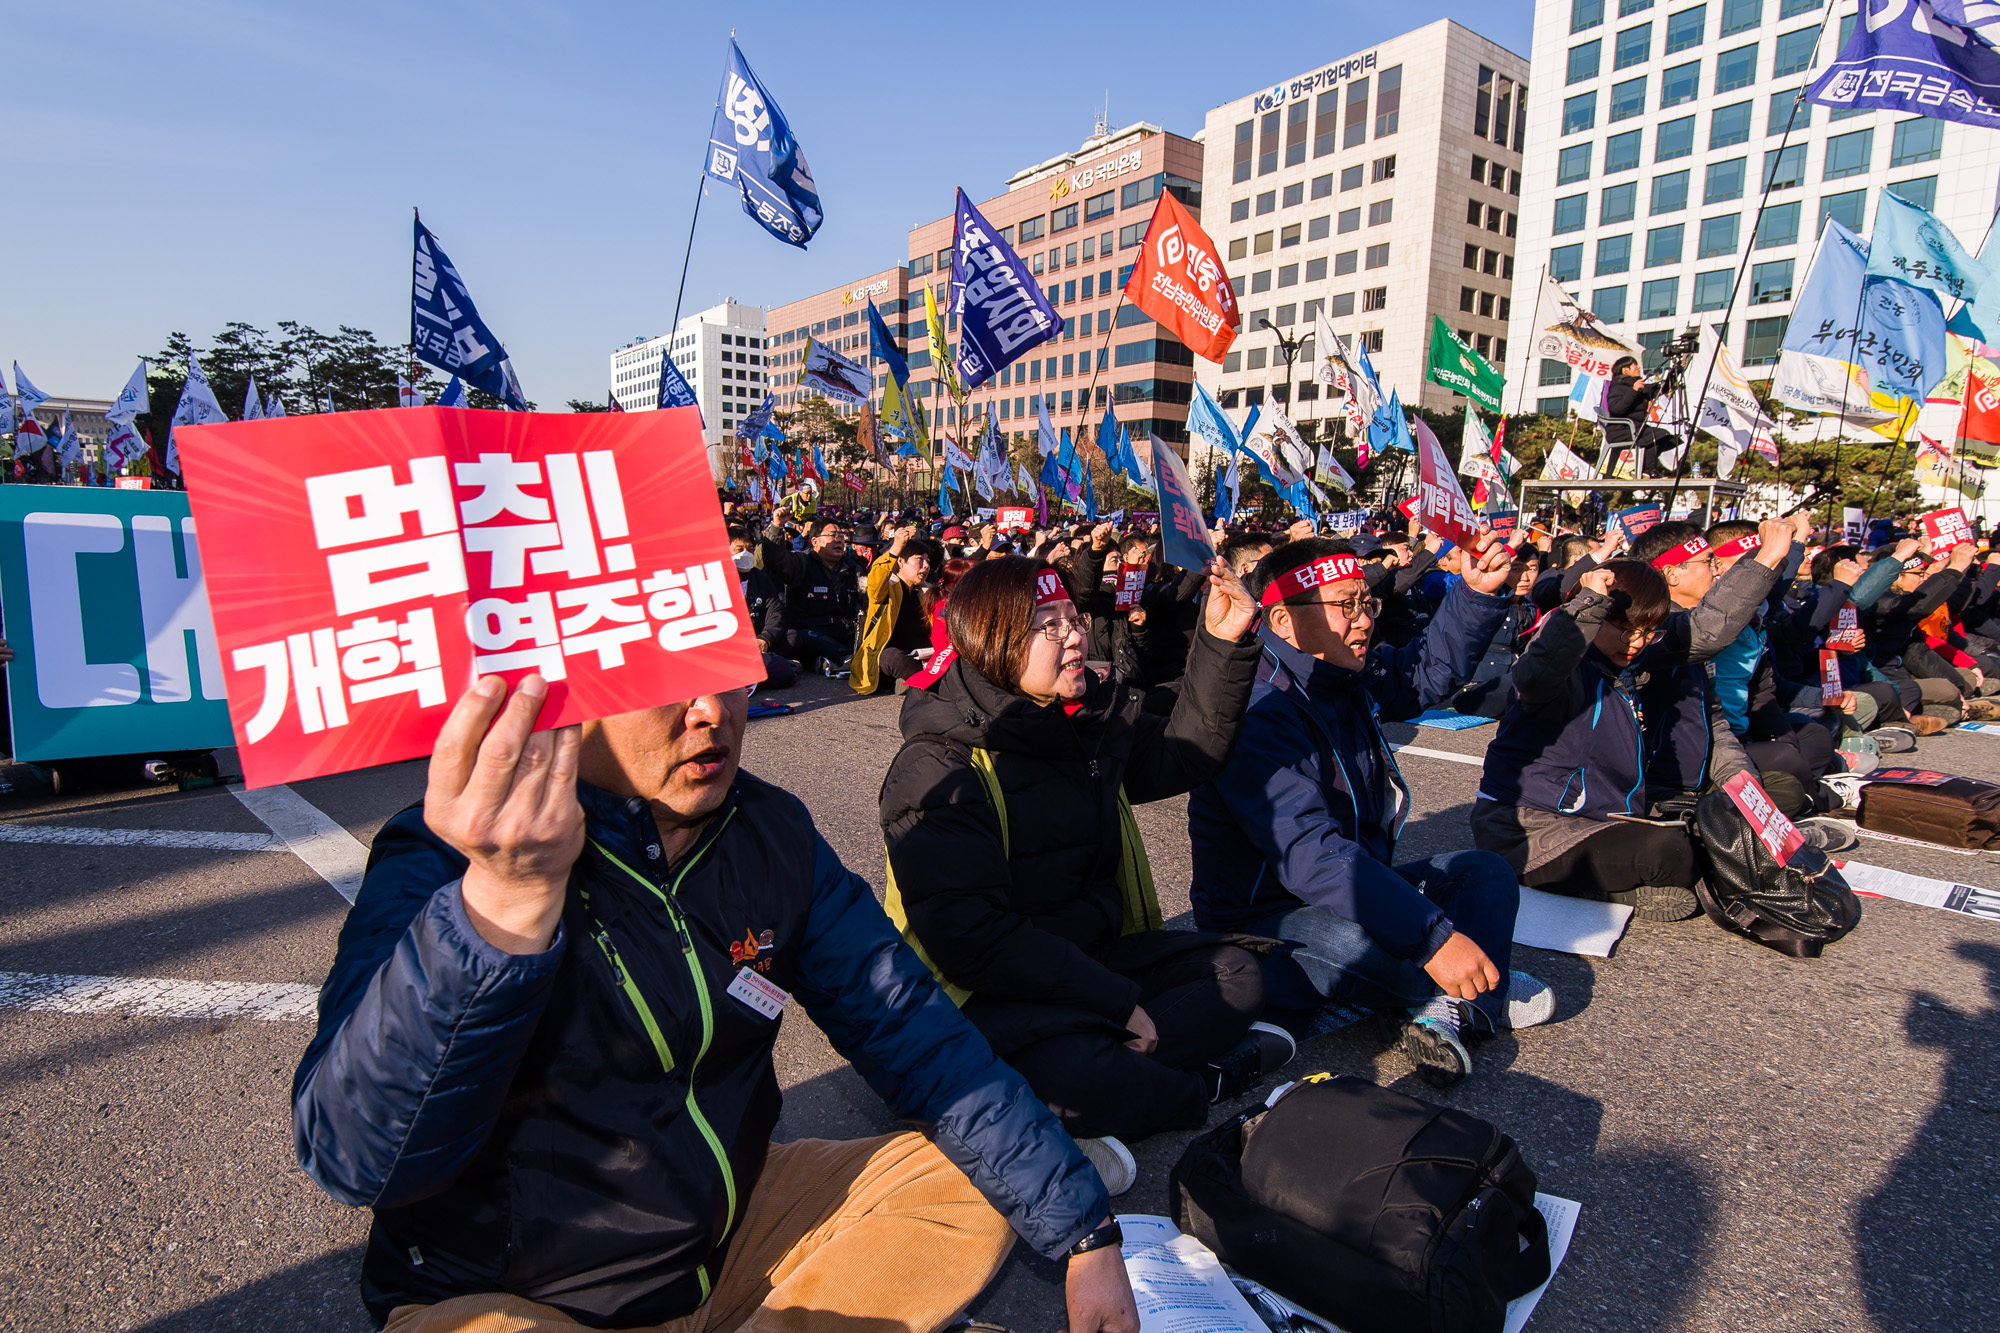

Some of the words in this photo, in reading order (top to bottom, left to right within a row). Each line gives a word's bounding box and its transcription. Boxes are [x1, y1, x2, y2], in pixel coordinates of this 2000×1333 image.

[1290, 50, 1377, 99] 한국기업데이터
[1152, 271, 1225, 336] 전남농민위원회
[1878, 295, 1906, 318] 전농
[1811, 319, 1924, 388] 부여군농민회
[1003, 510, 1025, 523] 멈춰!
[1421, 482, 1451, 525] 개혁
[305, 450, 637, 617] 멈춰!
[997, 522, 1011, 531] 개혁
[1932, 534, 1957, 552] 개혁
[1683, 534, 1708, 555] 단결
[1294, 557, 1341, 590] 단결
[1115, 591, 1133, 607] 개혁
[232, 607, 447, 744] 개혁
[466, 560, 740, 683] 역주행
[1760, 823, 1783, 856] 개혁
